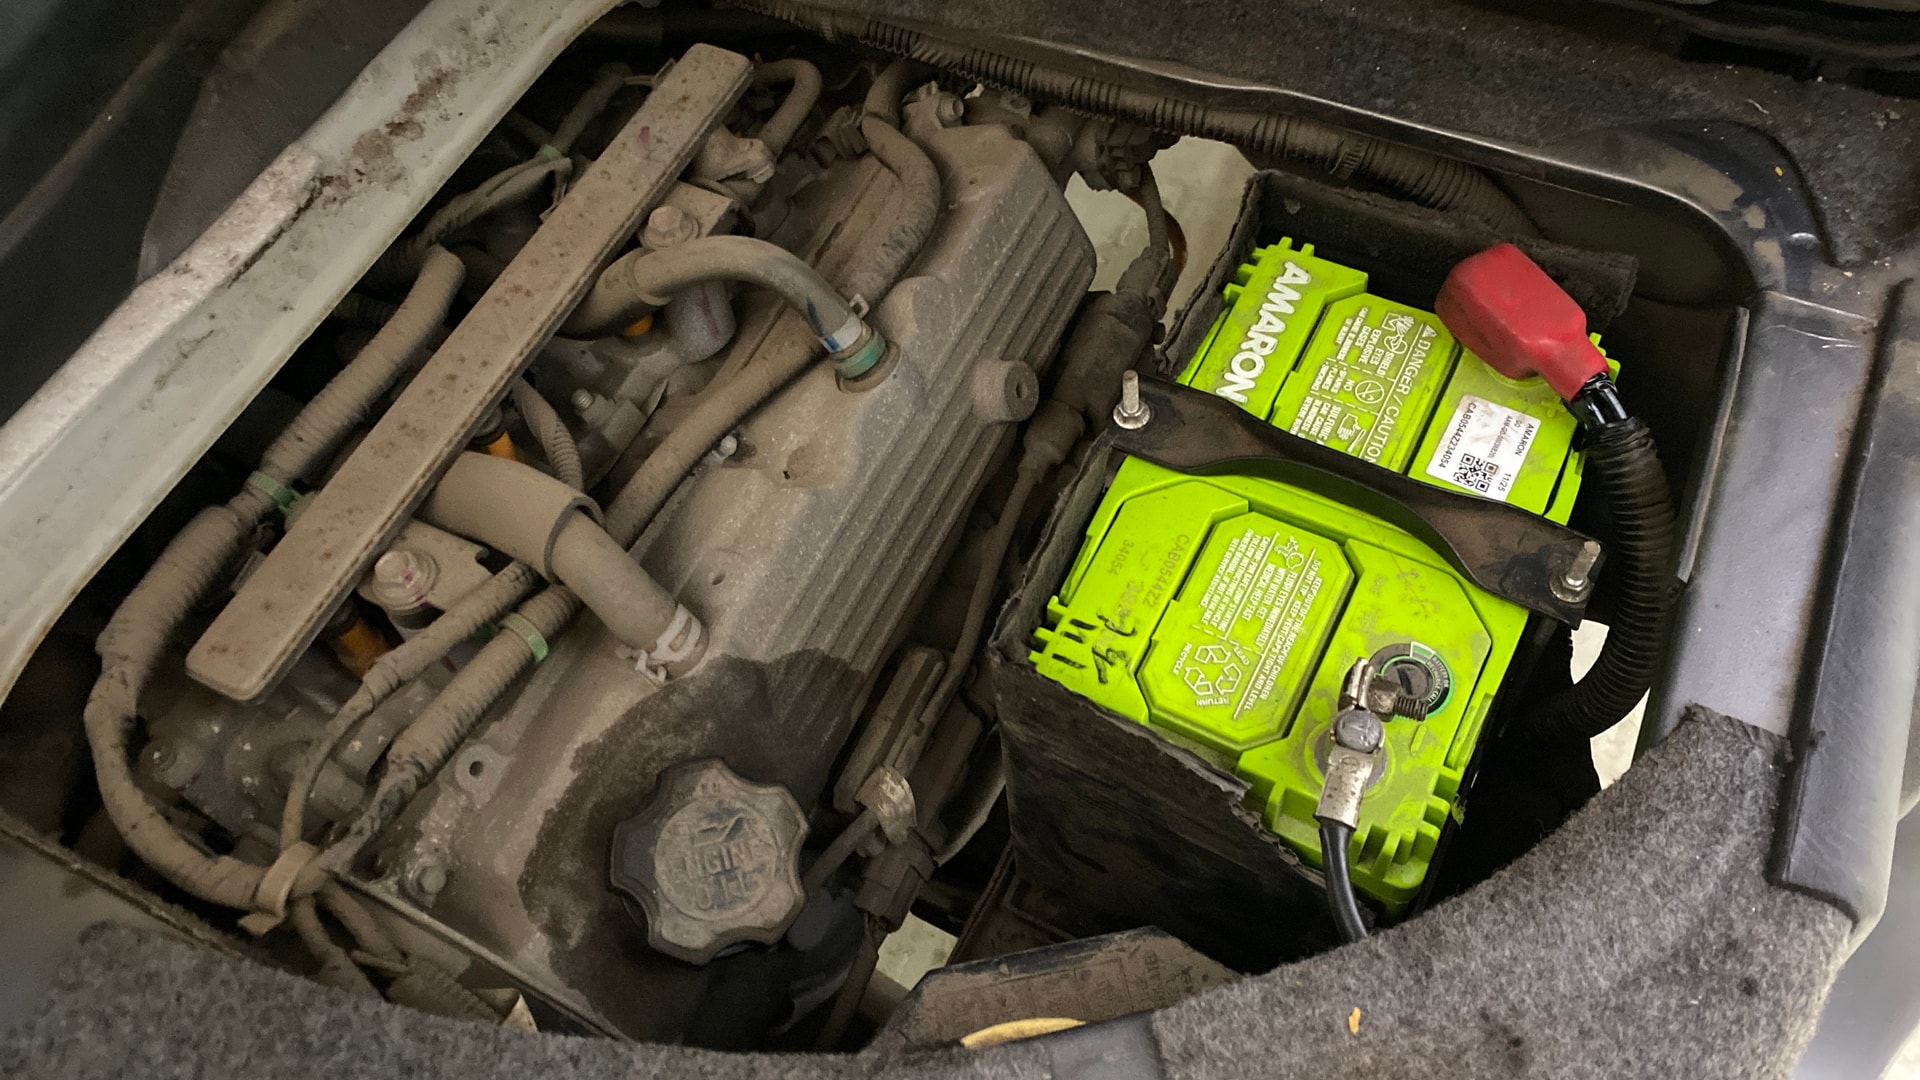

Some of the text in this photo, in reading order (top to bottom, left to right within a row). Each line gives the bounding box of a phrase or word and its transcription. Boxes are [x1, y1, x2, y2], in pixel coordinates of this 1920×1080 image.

[1215, 260, 1313, 405] AMARON
[1355, 325, 1371, 348] GASES
[1358, 328, 1381, 364] EXPLOSIVE
[1369, 347, 1383, 365] EYES
[1376, 351, 1394, 375] SHIELD
[1396, 339, 1430, 394] DANGER
[1342, 378, 1354, 391] NO
[1297, 396, 1313, 418] SEVERE
[1301, 399, 1321, 431] BLINDNESS
[1318, 405, 1341, 440] SULFURIC
[1309, 416, 1323, 436] CAUSE
[1364, 404, 1399, 464] CAUTION
[1438, 402, 1476, 468] CAB0544Z234054
[1497, 423, 1534, 491] AMARON 11/25
[1108, 539, 1134, 576] 34054
[1244, 534, 1260, 557] FOLLOW
[1143, 532, 1190, 609] CAB0544Z2
[1217, 536, 1270, 631] CAUTION: FOR SAFE JUMP STARTING
[1225, 557, 1249, 595] INSTRUCTIONS
[1272, 566, 1286, 583] WITH
[1241, 562, 1275, 621] MEDICAL HELP FAST
[1254, 570, 1297, 647] FLUSH EYES IMMEDIATELY
[1210, 603, 1226, 626] VEHICLE
[1255, 606, 1267, 619] GET
[1243, 559, 1320, 711] DO NOT TIP. KEEP VENT CAPS TIGHT AND LEVEL
[1259, 576, 1322, 700] KEEP OUT OF THE REACH OF CHILDREN
[1171, 642, 1192, 675] RECYCLE
[1233, 647, 1249, 664] LEAD
